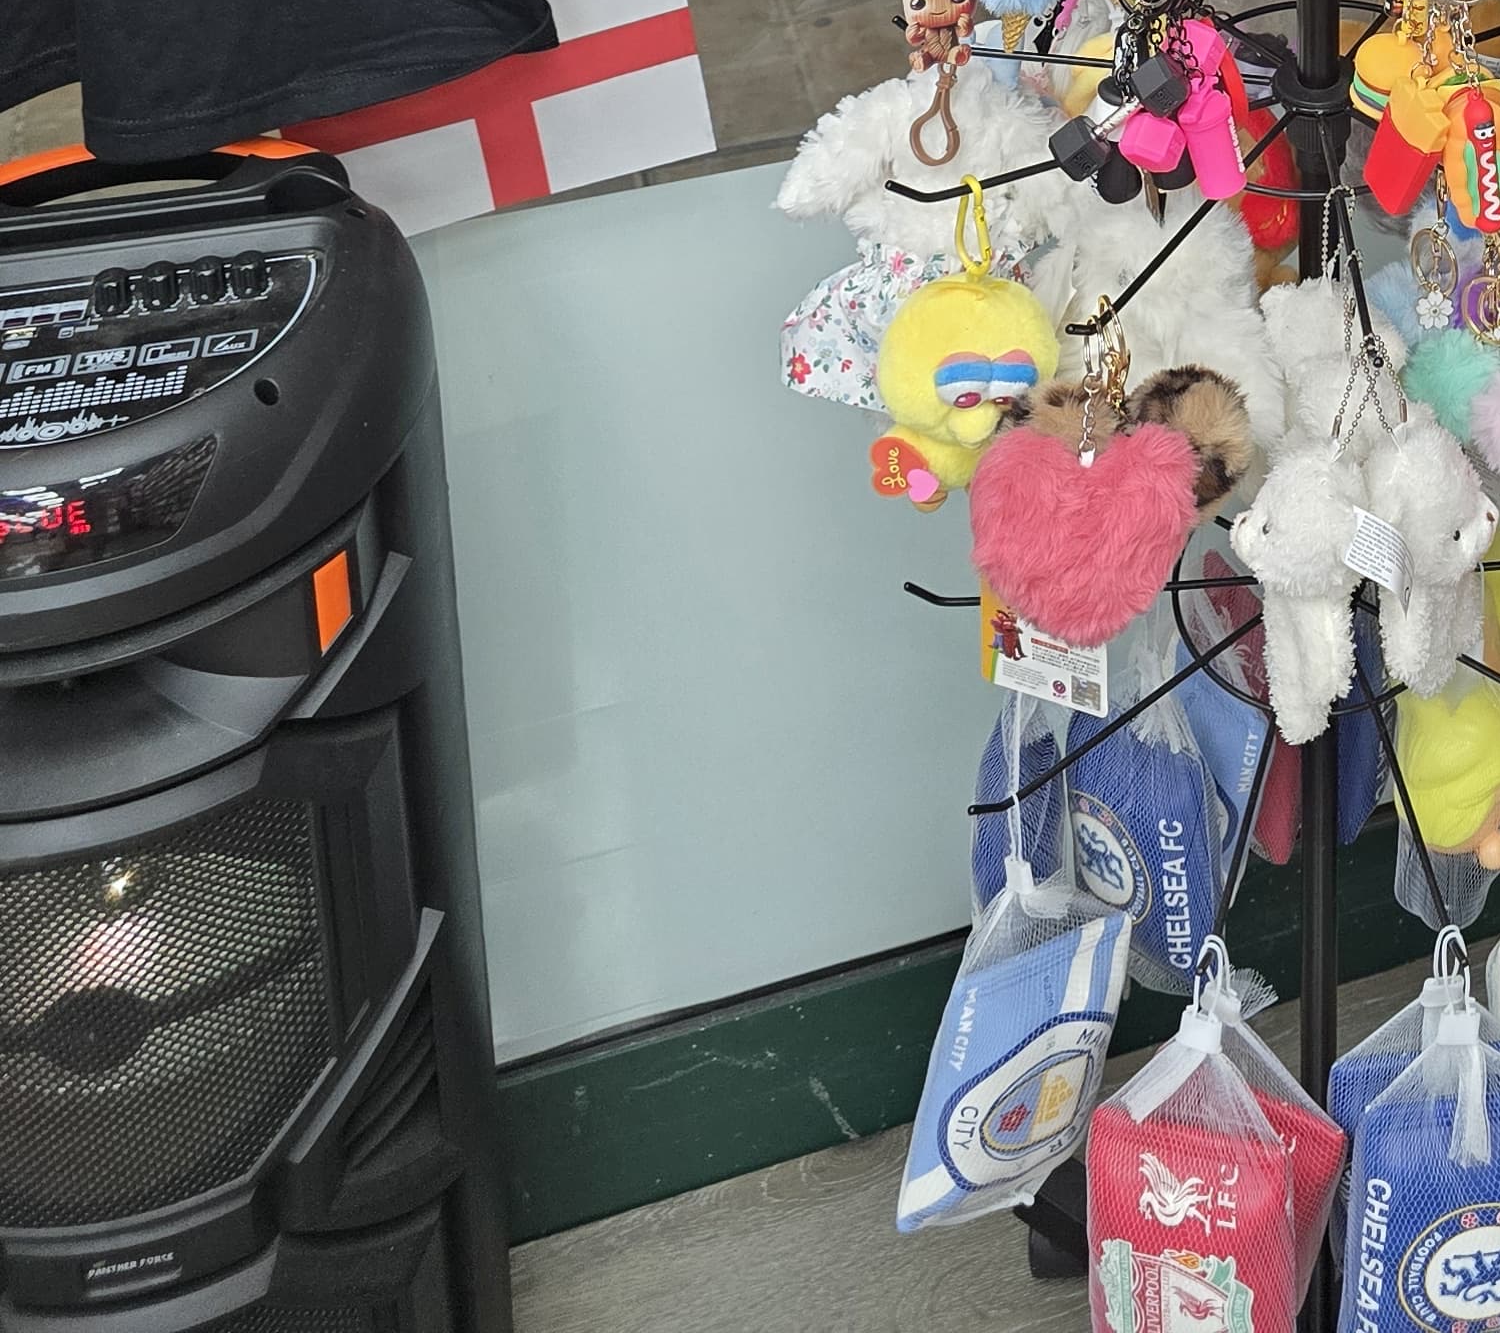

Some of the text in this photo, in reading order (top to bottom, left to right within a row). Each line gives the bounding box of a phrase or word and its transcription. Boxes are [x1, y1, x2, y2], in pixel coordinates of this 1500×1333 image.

[24, 363, 51, 375] FM
[83, 349, 127, 364] TWS
[881, 446, 907, 489] Love
[1242, 733, 1260, 769] CITY
[1158, 817, 1193, 970] CHELSEA FC
[948, 986, 978, 1073] MAN CITY
[951, 1104, 979, 1151] CITY
[87, 1251, 175, 1280] PANTHER FORCE
[1356, 1177, 1392, 1311] CHELSEA
[1408, 1231, 1444, 1324] FOOTBALL CLUB
